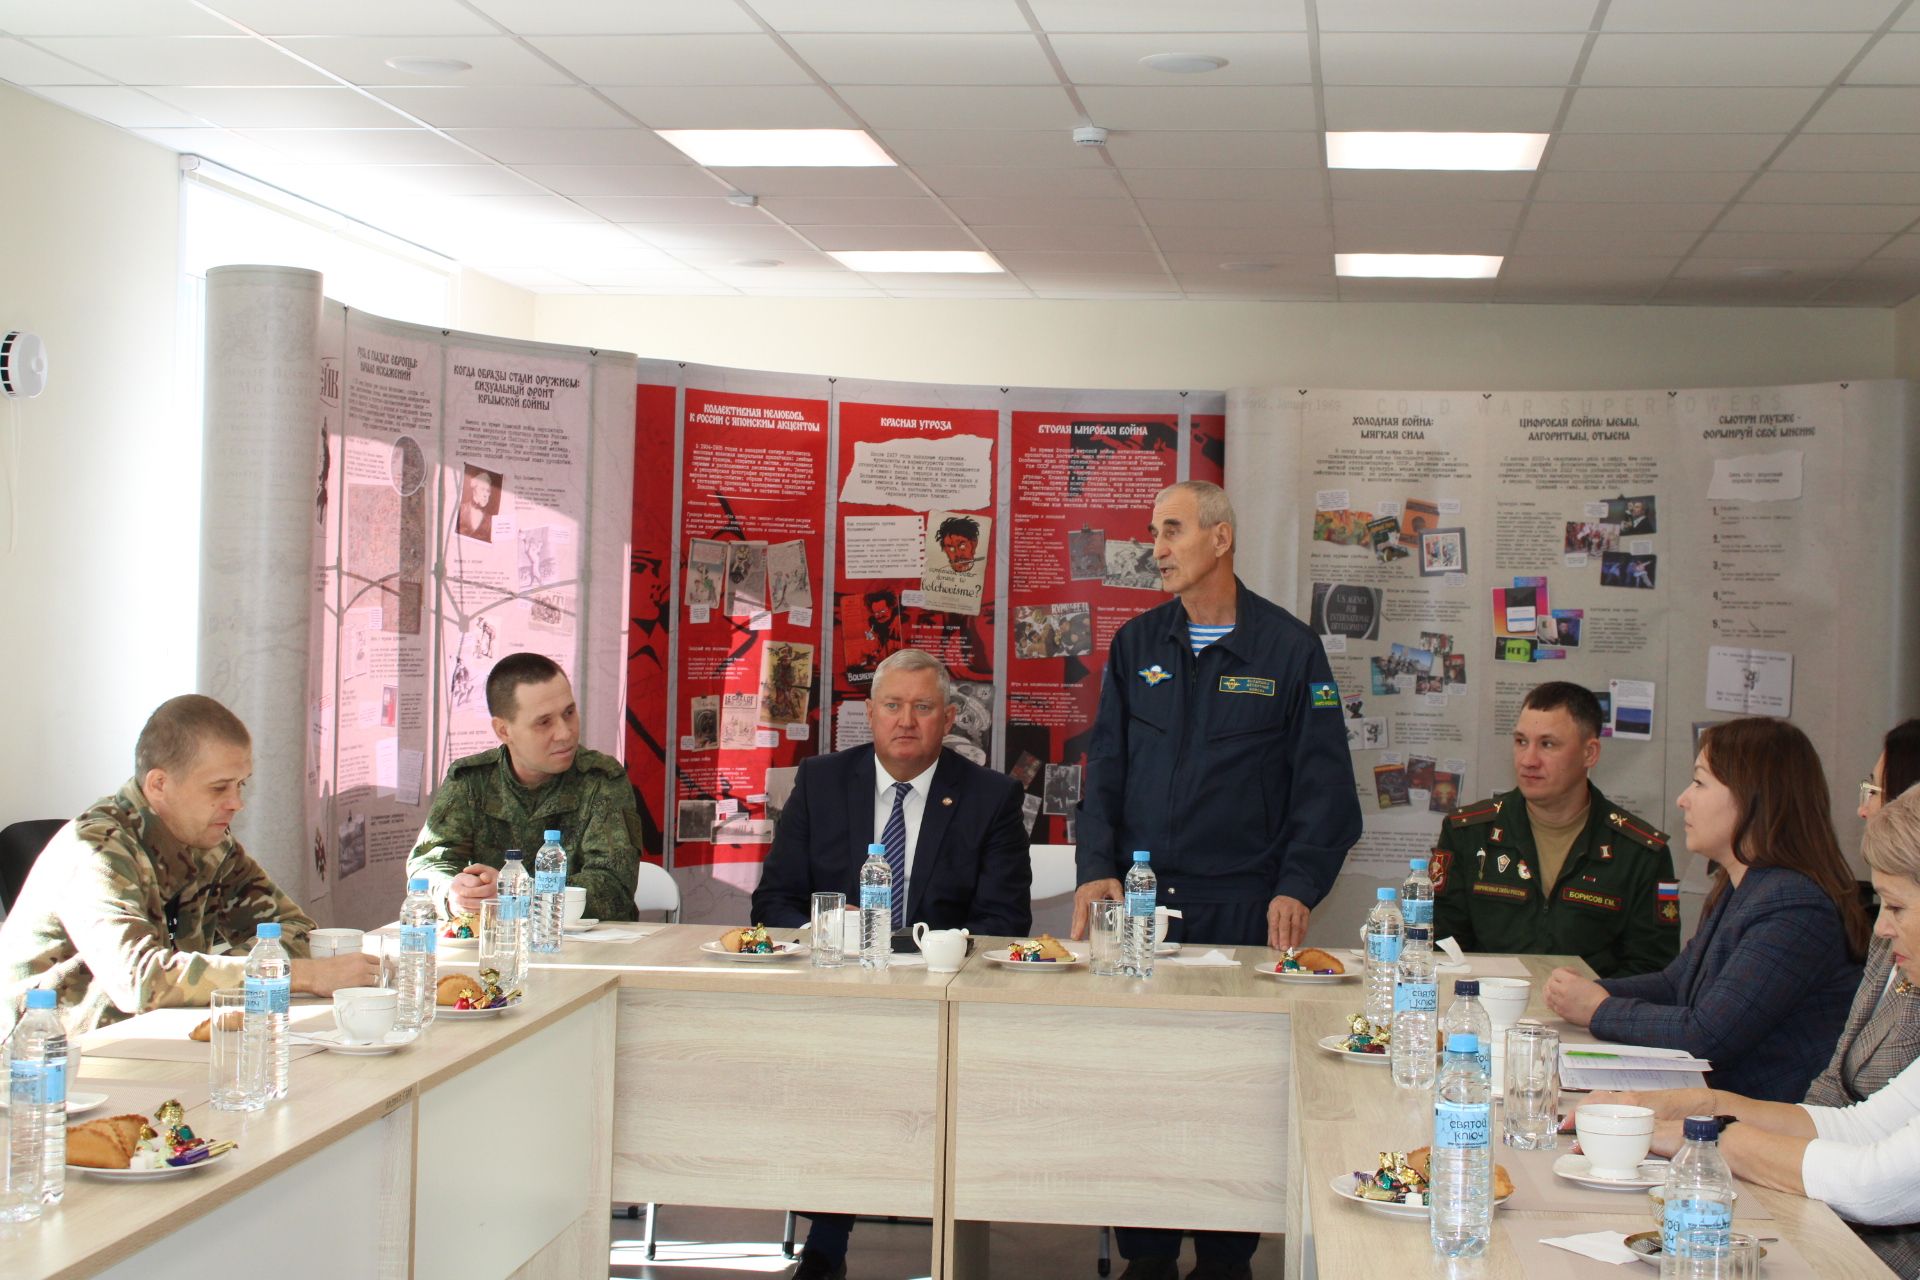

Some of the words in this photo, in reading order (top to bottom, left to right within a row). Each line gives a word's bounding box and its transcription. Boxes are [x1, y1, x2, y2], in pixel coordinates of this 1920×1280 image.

[454, 365, 476, 377] КОГДА
[478, 368, 506, 380] ОБРАЗЫ
[509, 372, 532, 384] СТАЛИ
[536, 376, 580, 388] ОРУЖИЕМ:
[474, 380, 524, 396] ВИЗУАЛЬНЫЙ
[527, 388, 554, 398] ФРОНТ
[478, 394, 520, 408] КРЫМСКОЙ
[522, 397, 550, 410] ВОЙНЫ
[704, 404, 761, 418] КОЛЛЕКТИВНАЯ
[764, 408, 804, 420] НЕЛЮБОВЬ
[690, 413, 695, 422] К
[696, 414, 724, 424] РОССИИ
[725, 417, 730, 425] С
[732, 417, 775, 428] ЯПОНСКИМ
[777, 420, 820, 432] АКЦЕНТОМ
[880, 418, 916, 428] КРАСНАЯ
[920, 420, 952, 430] УГРОЗА
[1352, 416, 1398, 427] ХОЛОДНАЯ
[1402, 415, 1434, 426] ВОЙНА:
[1520, 418, 1568, 428] ЦИФРОВАЯ
[1572, 416, 1603, 427] ВОЙНА:
[1606, 418, 1640, 428] МЕМЫ,
[1719, 415, 1756, 424] СМОТРИ
[1038, 424, 1072, 434] ВТОРАЯ
[1074, 426, 1116, 435] МИРОВАЯ
[1120, 424, 1148, 436] ВОЙНА
[1360, 430, 1398, 440] МЯГКАЯ
[1402, 430, 1424, 440] СИЛА
[1703, 427, 1752, 440] ФОРМИРУЙ
[1528, 432, 1590, 442] АЛГОРИТМЫ,
[1592, 432, 1630, 440] ОТМЕНА
[1569, 891, 1602, 904] БОРИСОВ
[1450, 1120, 1486, 1129] СВЯТОЙ
[1455, 1132, 1484, 1142] КЛЮЧ
